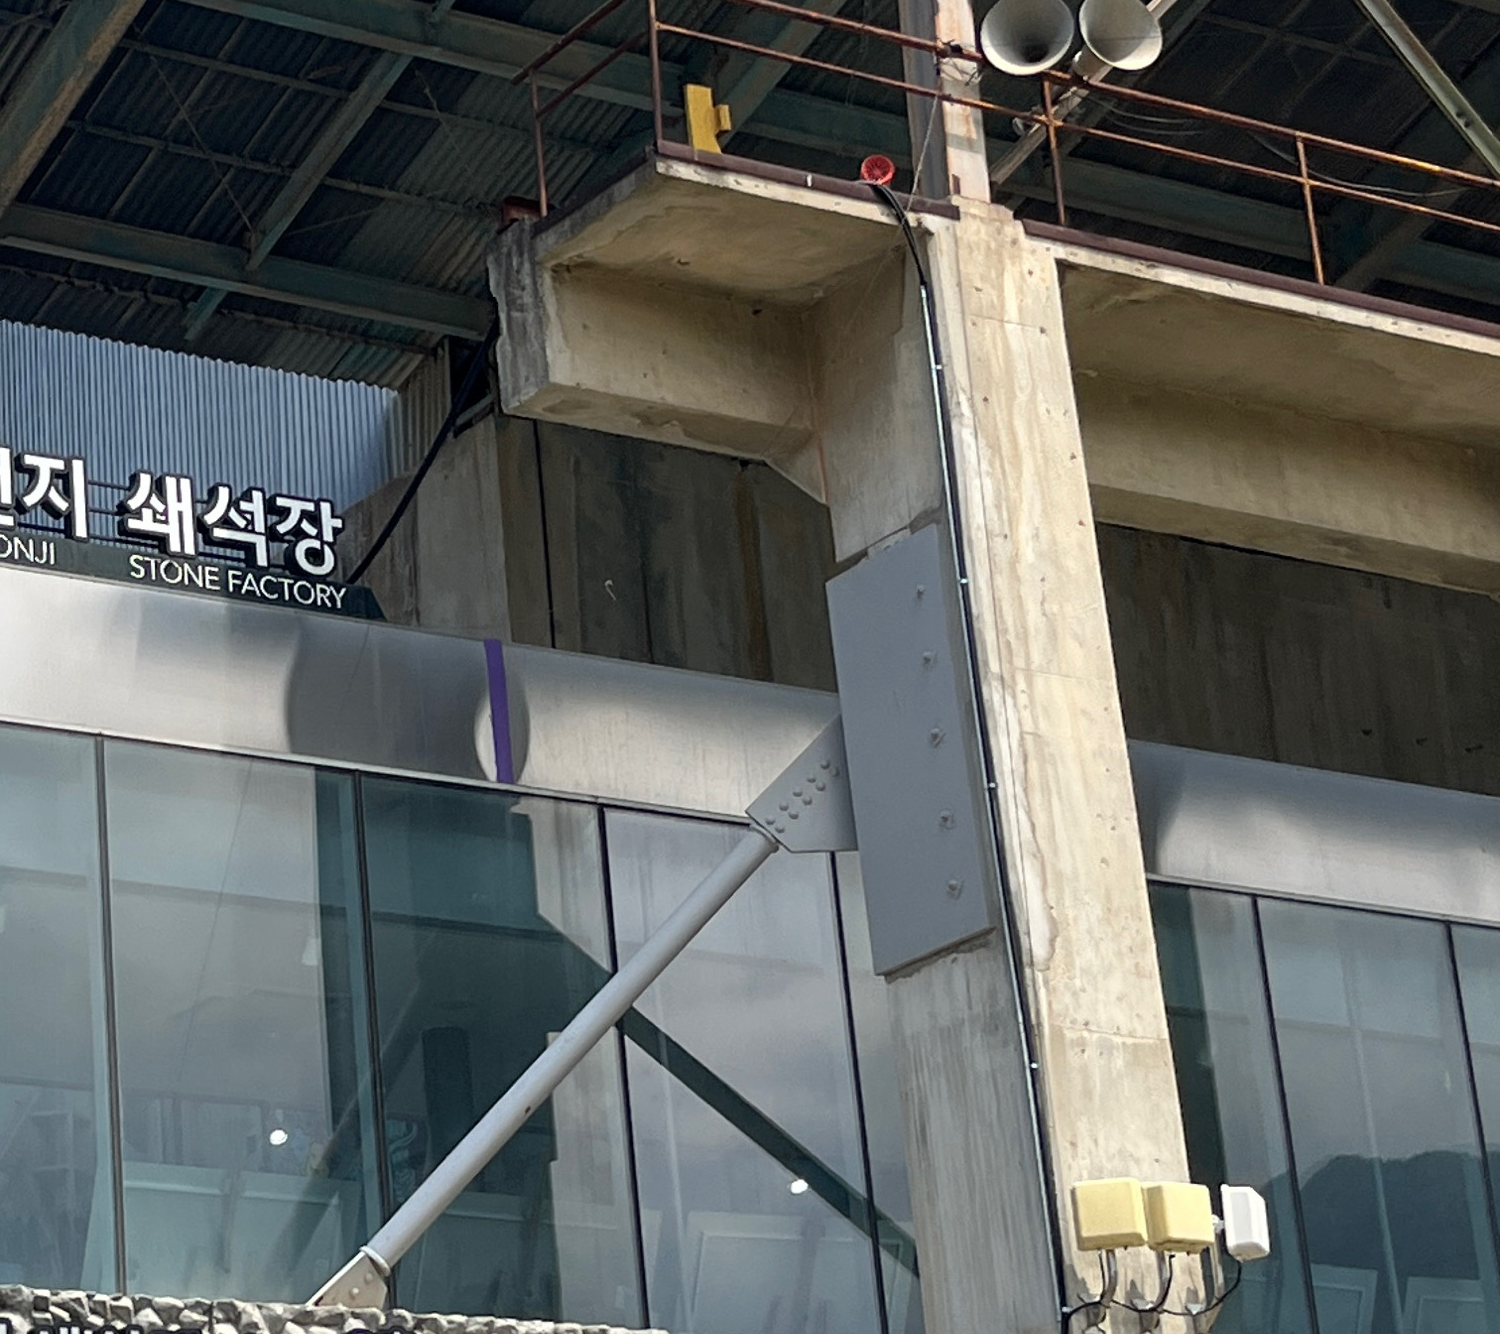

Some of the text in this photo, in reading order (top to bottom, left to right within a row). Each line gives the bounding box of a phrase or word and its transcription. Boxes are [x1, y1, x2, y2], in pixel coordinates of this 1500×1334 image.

[126, 471, 342, 576] 쇄석장
[128, 554, 220, 591] STONE
[227, 570, 347, 609] FACTORY
